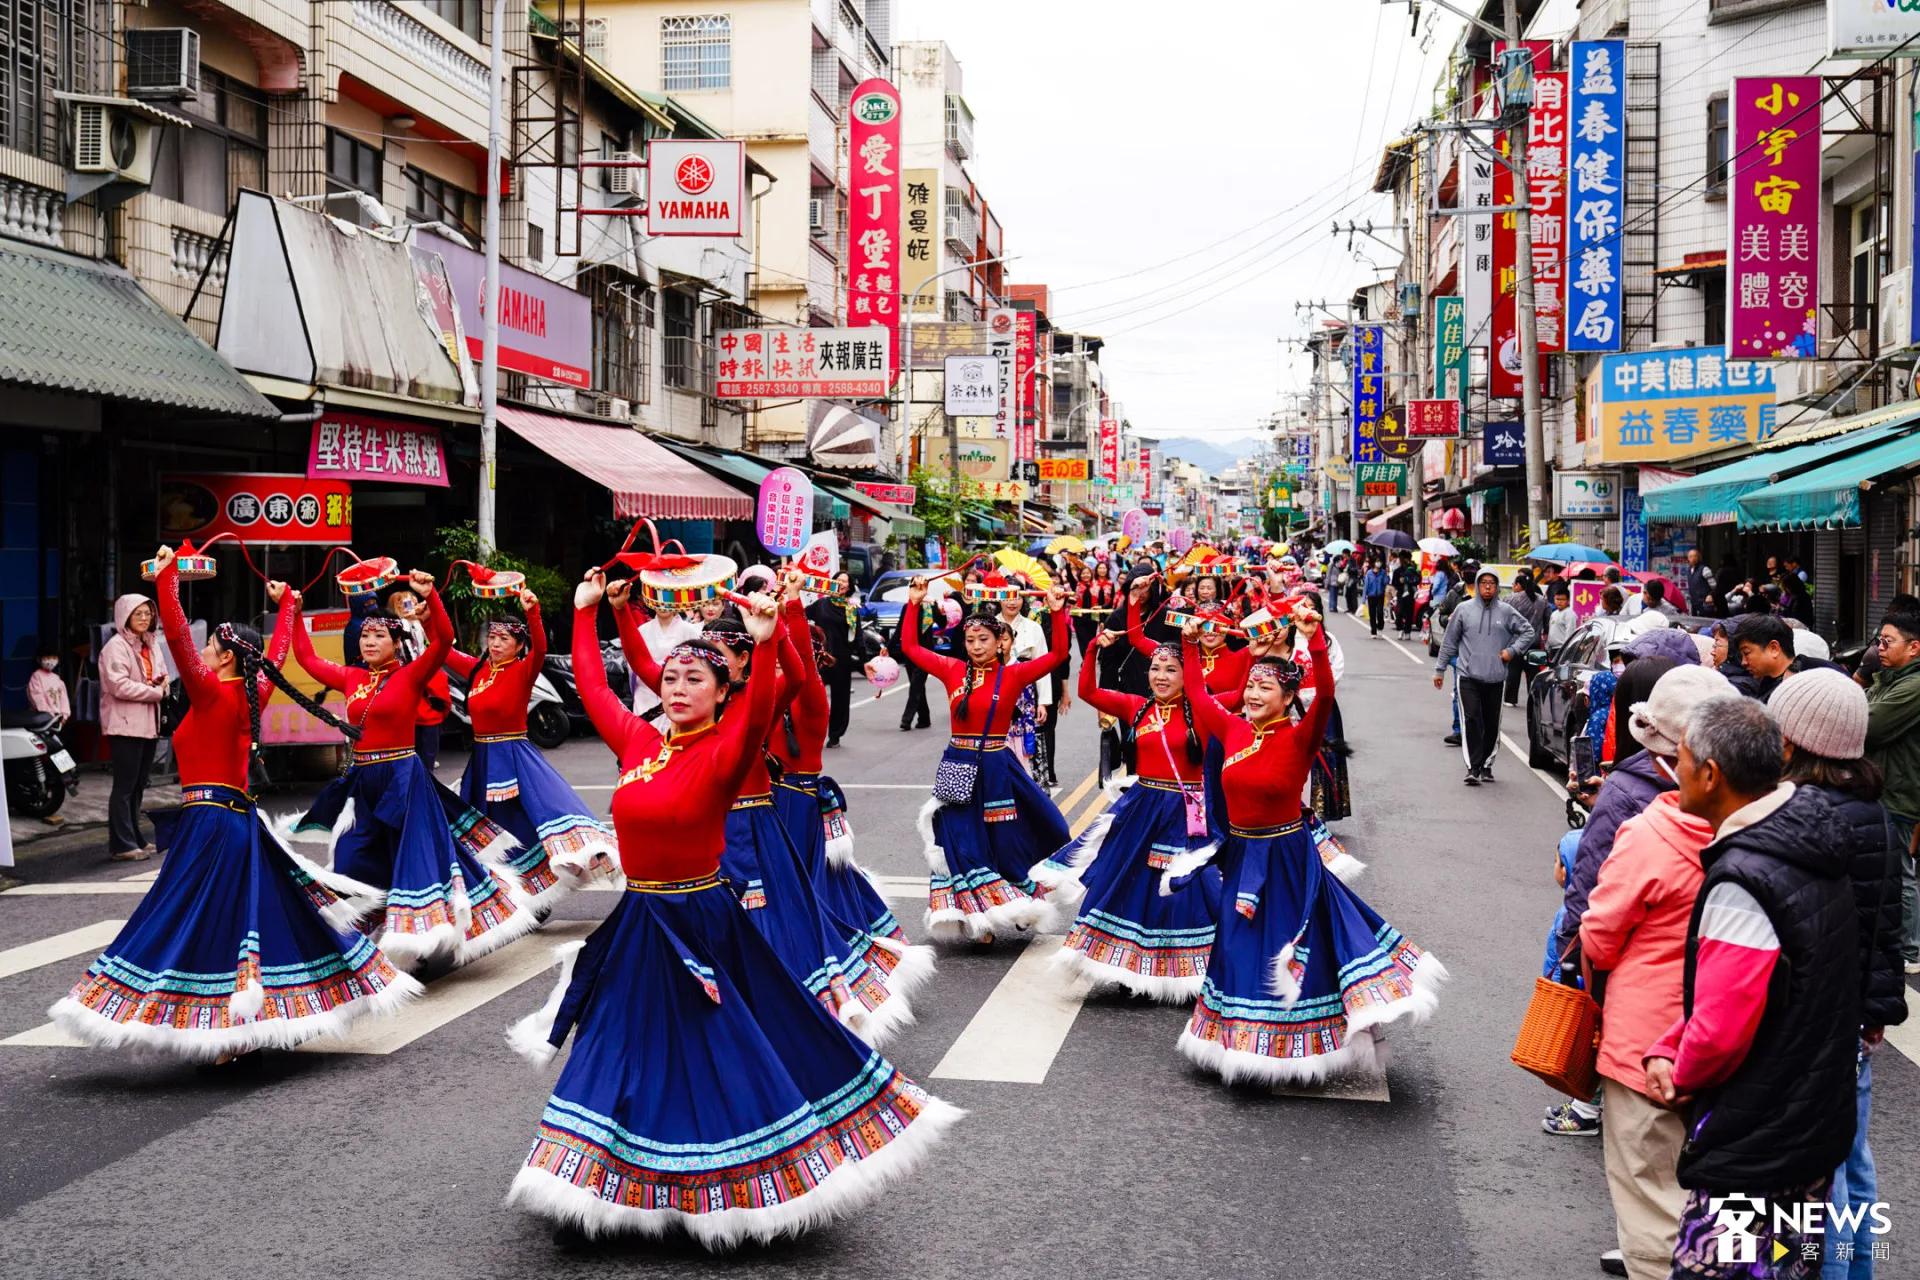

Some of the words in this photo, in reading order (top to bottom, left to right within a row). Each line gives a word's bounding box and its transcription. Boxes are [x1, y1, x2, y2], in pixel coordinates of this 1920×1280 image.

[1855, 32, 1920, 44] 交通部觀光
[1755, 83, 1801, 215] 小宇宙
[658, 201, 730, 220] YAMAHA
[859, 133, 895, 270] 愛丁堡
[1573, 48, 1618, 343] 益春健保藥局
[907, 182, 930, 261] 雅曼妮
[1740, 223, 1770, 309] 美體
[1778, 223, 1809, 309] 美容
[855, 274, 872, 313] 蛋糕
[875, 274, 893, 314] 麵包
[819, 341, 883, 371] 夾報廣告
[1443, 302, 1463, 366] 伊佳伊
[951, 384, 994, 398] 茶森林
[315, 421, 441, 478] 堅持生米熬粥
[1361, 465, 1401, 481] 伊佳伊
[232, 496, 317, 521] 廣東粥
